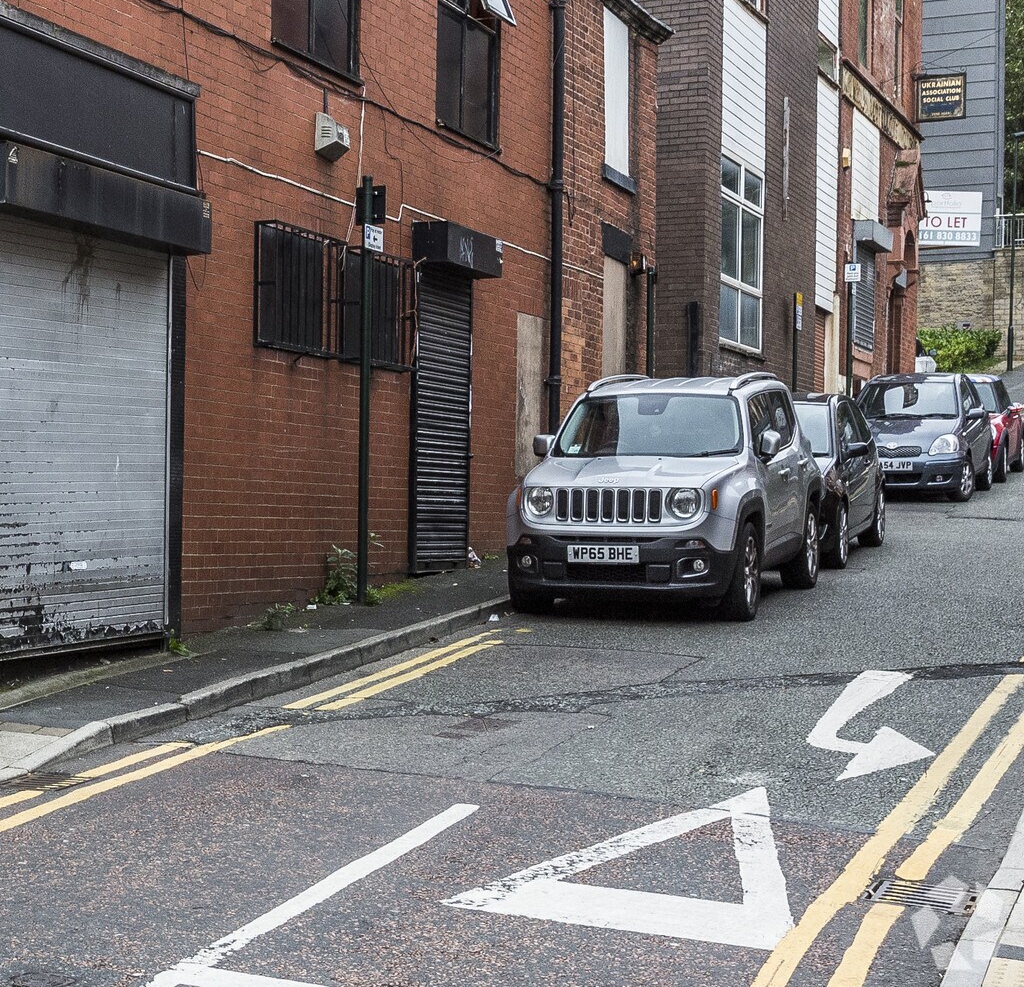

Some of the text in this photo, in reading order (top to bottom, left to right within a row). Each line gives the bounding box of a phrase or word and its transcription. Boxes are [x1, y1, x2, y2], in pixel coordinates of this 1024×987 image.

[921, 79, 962, 89] UKRAINIAN
[921, 88, 962, 97] ASSOCIATION
[925, 216, 967, 228] TO LET
[919, 231, 977, 241] 161 830 8833
[896, 461, 912, 469] JVP
[572, 546, 633, 560] WP65 BHE
